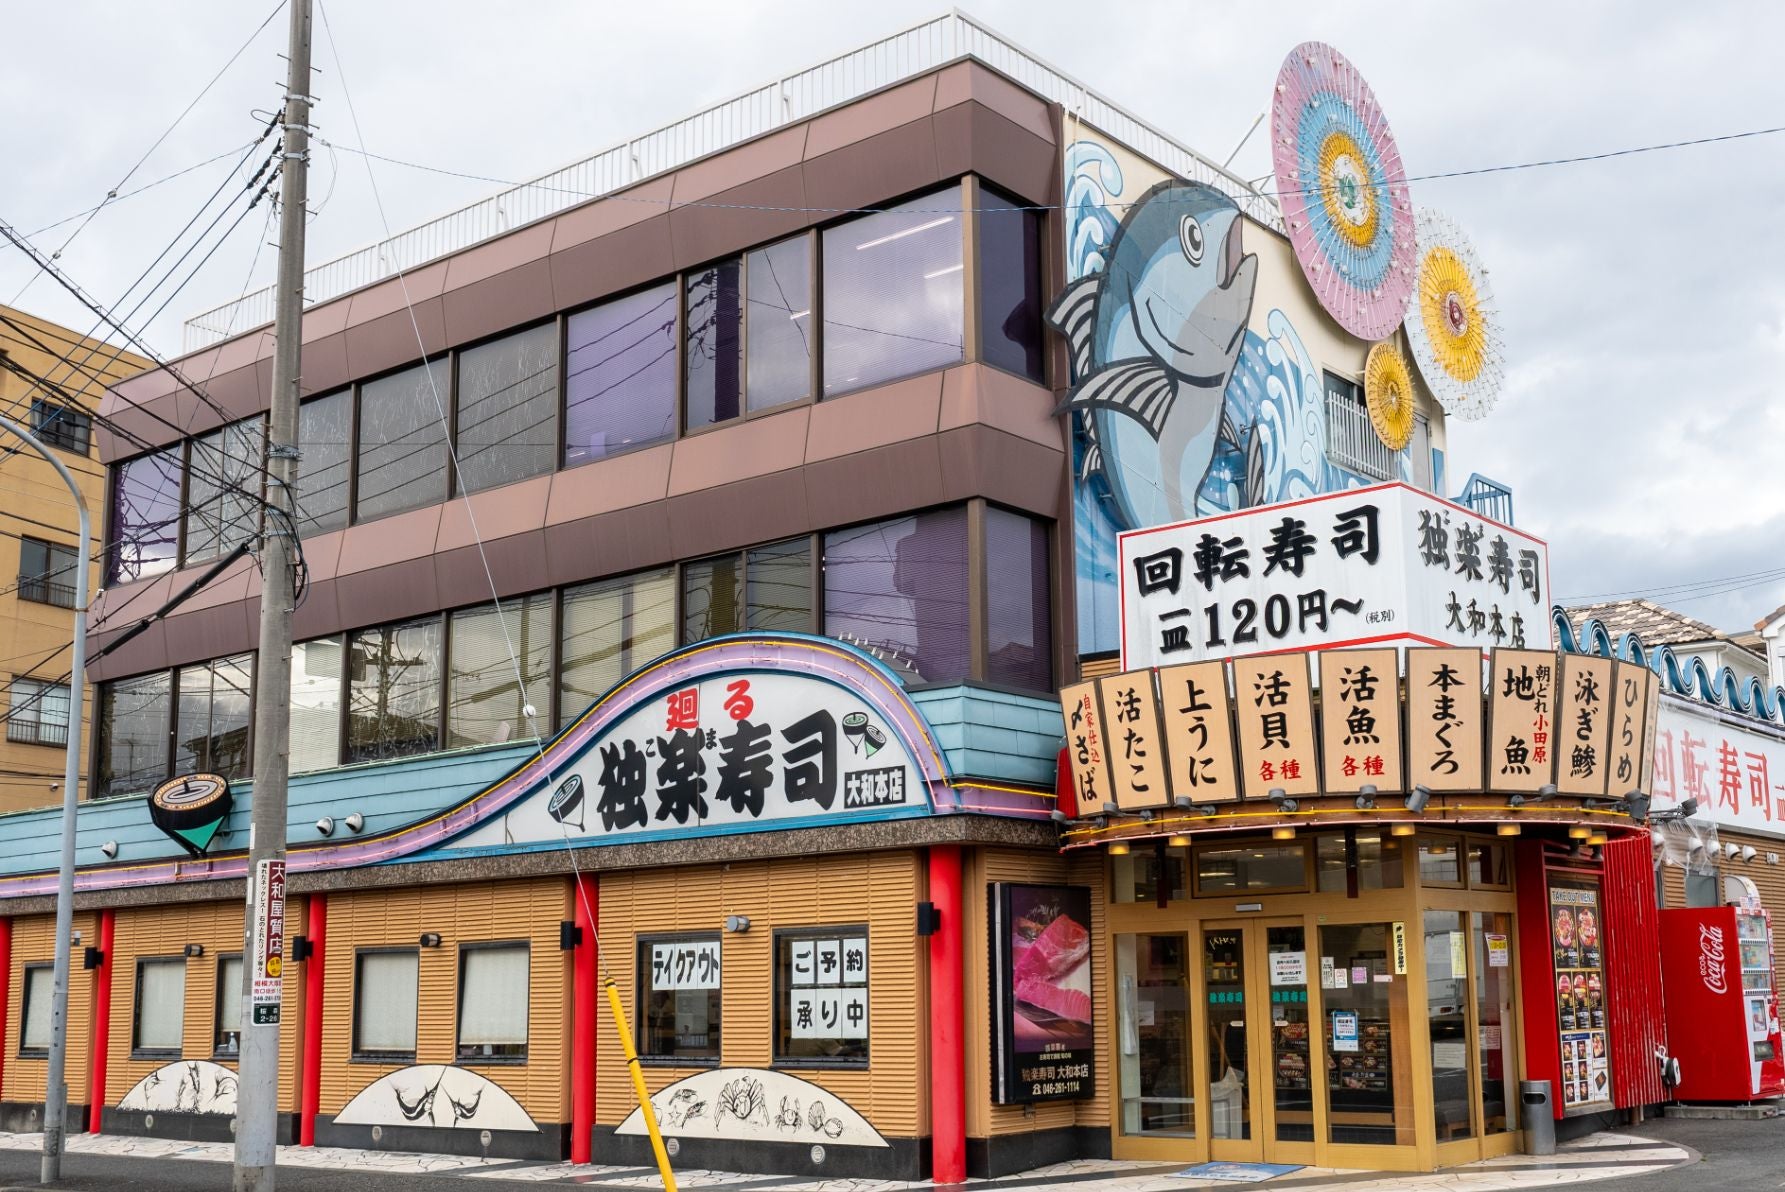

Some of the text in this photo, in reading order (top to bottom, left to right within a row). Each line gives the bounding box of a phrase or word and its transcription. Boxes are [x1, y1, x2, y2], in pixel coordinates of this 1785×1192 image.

[1133, 504, 1381, 598] 回転寿司
[1418, 509, 1541, 605] 独楽寿司
[1445, 590, 1526, 649] 大和本店
[666, 680, 754, 732] 廻る
[1083, 694, 1101, 764] 自家仕込
[1115, 687, 1150, 793] 活たこ
[1179, 679, 1217, 788] 上うに
[1253, 670, 1291, 751] 活貝
[1340, 665, 1380, 746] 活魚
[1427, 663, 1466, 775] 本まぐろ
[1501, 665, 1535, 775] 地魚
[1617, 678, 1638, 784] ひらめ
[597, 708, 837, 832] 独楽寿司
[847, 773, 902, 806] 大和本店
[1258, 758, 1302, 782] 各種
[1341, 755, 1385, 777] 各種
[269, 864, 286, 955] 大和屋質店
[653, 947, 719, 985] テイクアウト
[795, 948, 863, 974] ご予約
[797, 999, 863, 1029] 承り中
[1057, 1064, 1089, 1079] 大和本店
